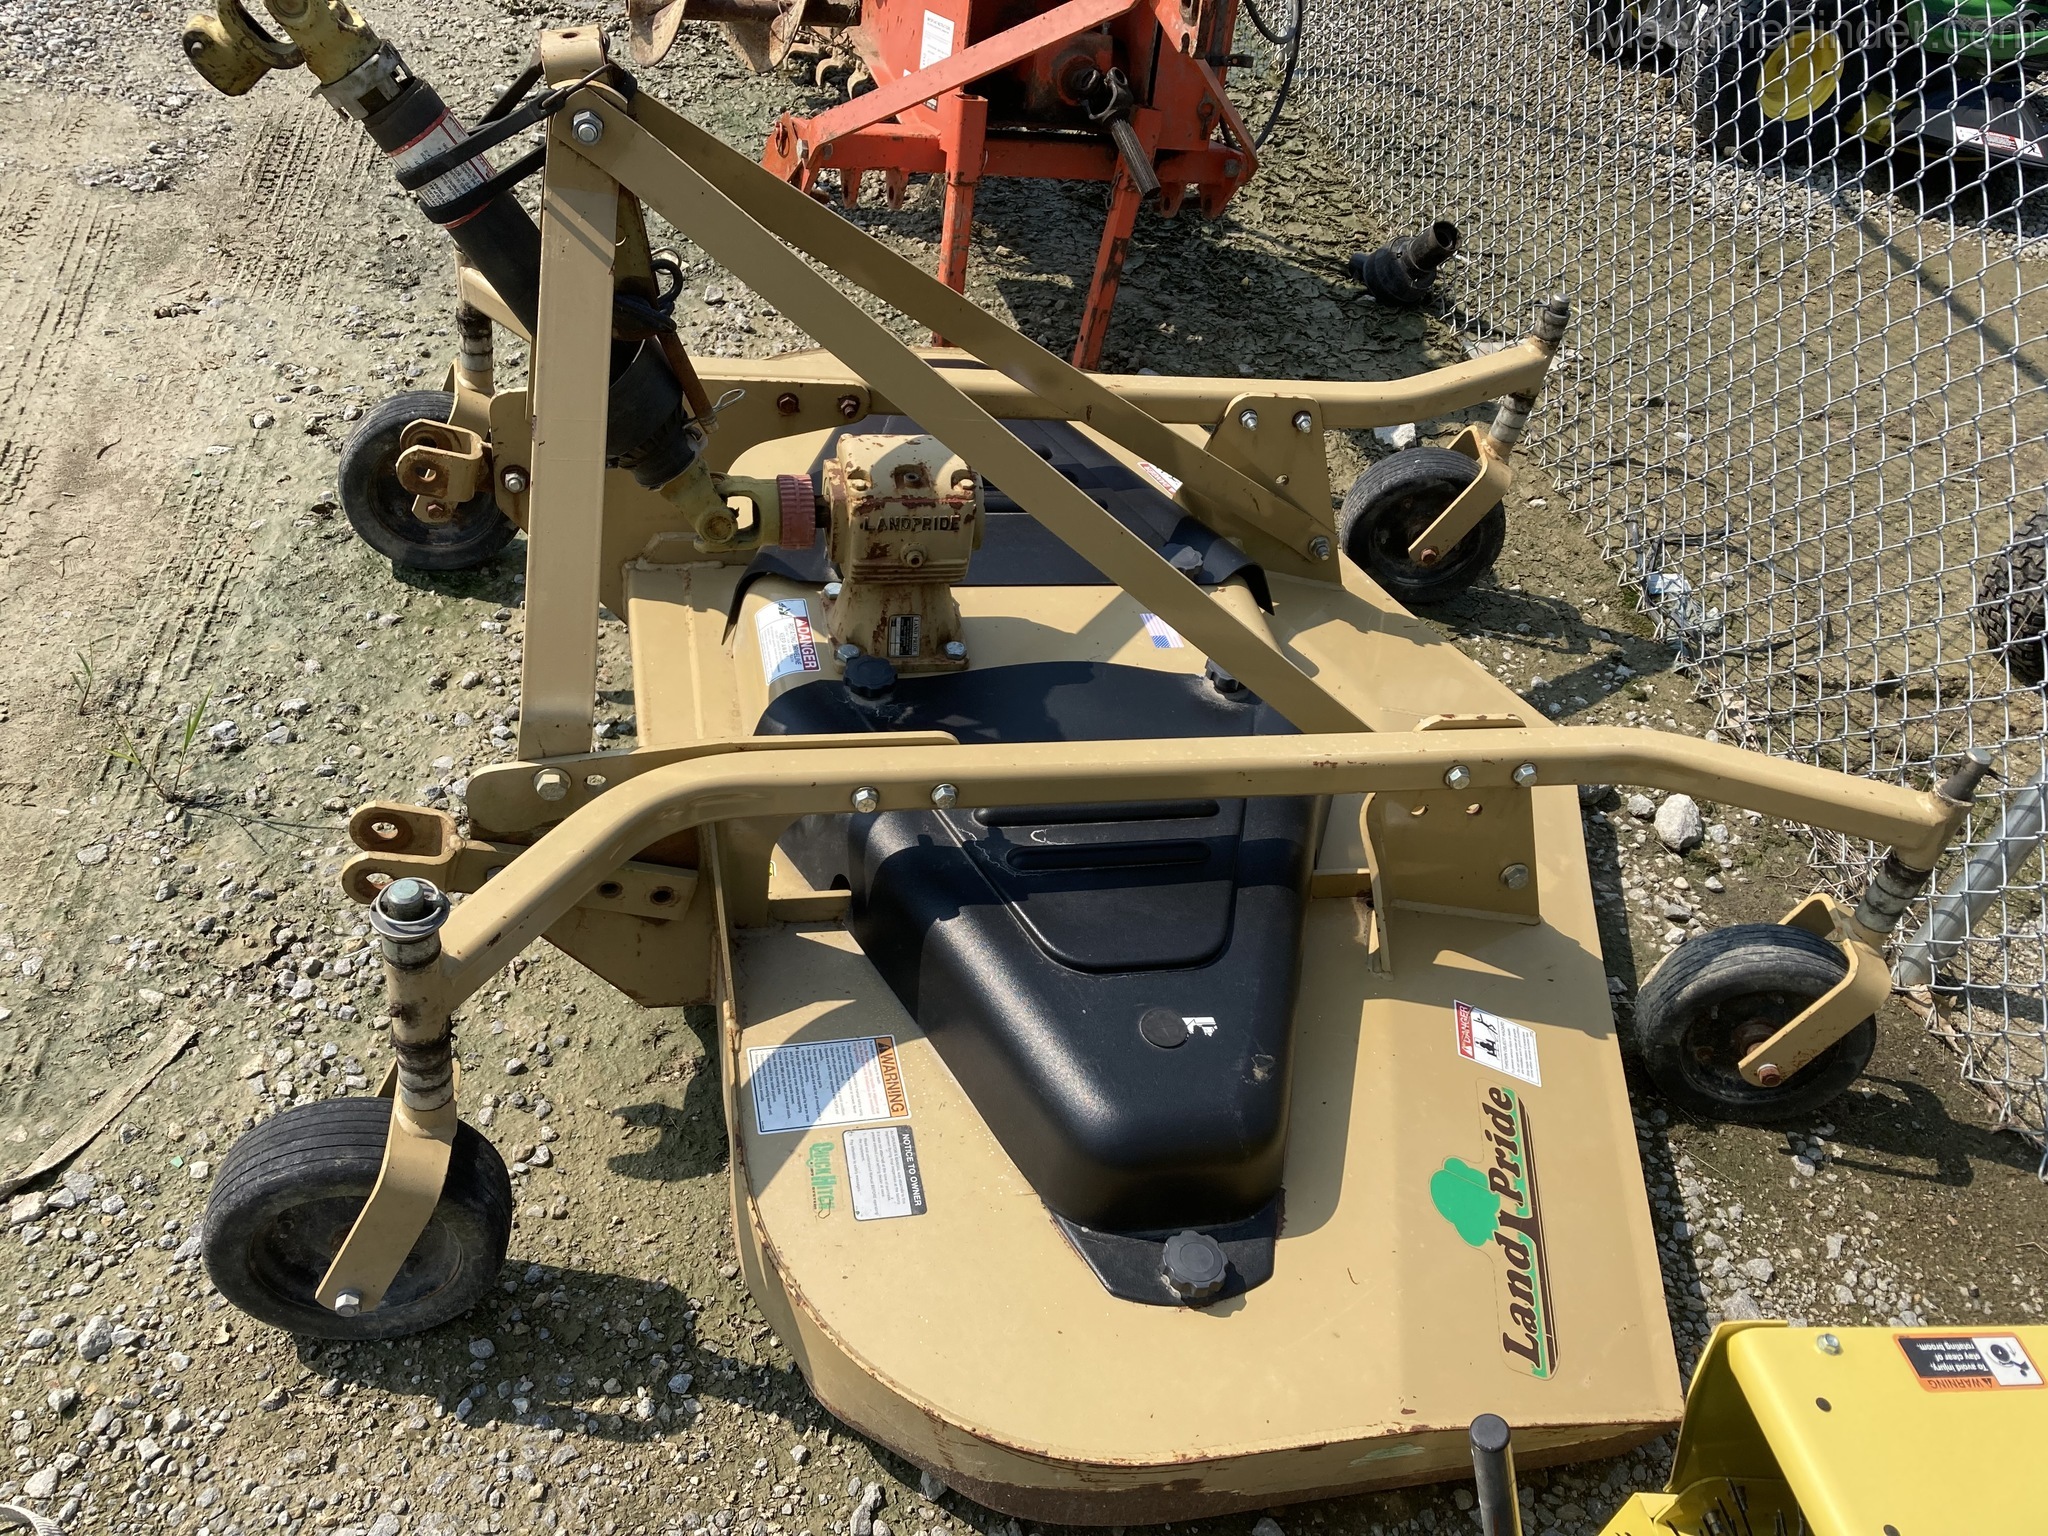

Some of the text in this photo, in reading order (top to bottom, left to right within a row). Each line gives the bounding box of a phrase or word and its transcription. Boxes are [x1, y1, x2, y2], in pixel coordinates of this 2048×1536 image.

[864, 515, 961, 532] LANDPRIDE
[796, 627, 817, 668] DANGER
[1458, 1004, 1471, 1044] DANGER
[879, 1052, 905, 1112] WARNING
[1482, 1087, 1523, 1207] Pride
[901, 1133, 922, 1205] NOTICE TO OWNER
[1494, 1231, 1541, 1368] Land
[1916, 1340, 1975, 1351] rotating broom.
[1935, 1352, 1981, 1361] stay clear of
[1928, 1378, 1982, 1389] WARNING
[1930, 1362, 1989, 1372] To avoid injury,
